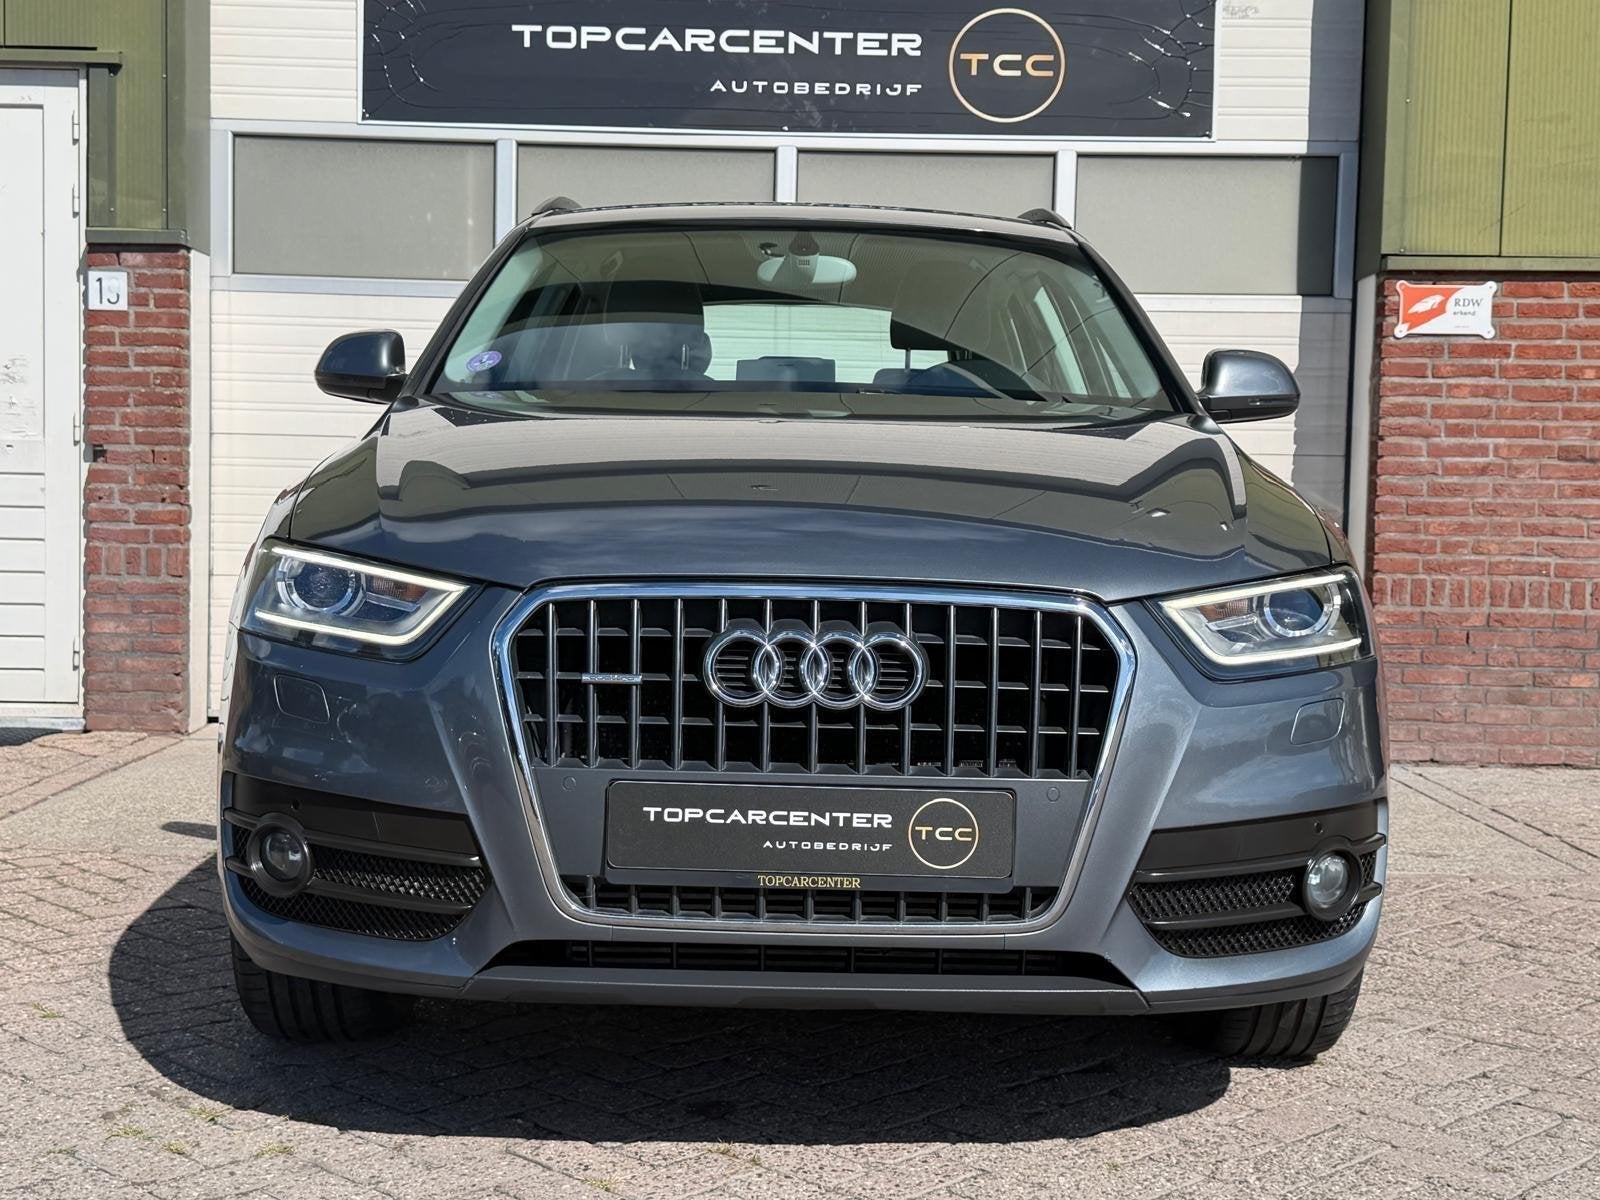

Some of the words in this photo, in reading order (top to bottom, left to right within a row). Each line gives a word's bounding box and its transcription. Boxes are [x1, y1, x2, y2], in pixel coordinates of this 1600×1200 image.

[511, 24, 922, 57] TOPCARCENTER
[959, 52, 1055, 78] TCC
[710, 79, 922, 96] AUTOBEDRIJF
[1453, 297, 1484, 308] RDW
[642, 806, 893, 829] TOPCARCENTER
[914, 825, 973, 842] TCC
[762, 840, 893, 852] AUTOBEDRIJF
[757, 874, 862, 890] TOPCARCENTER
